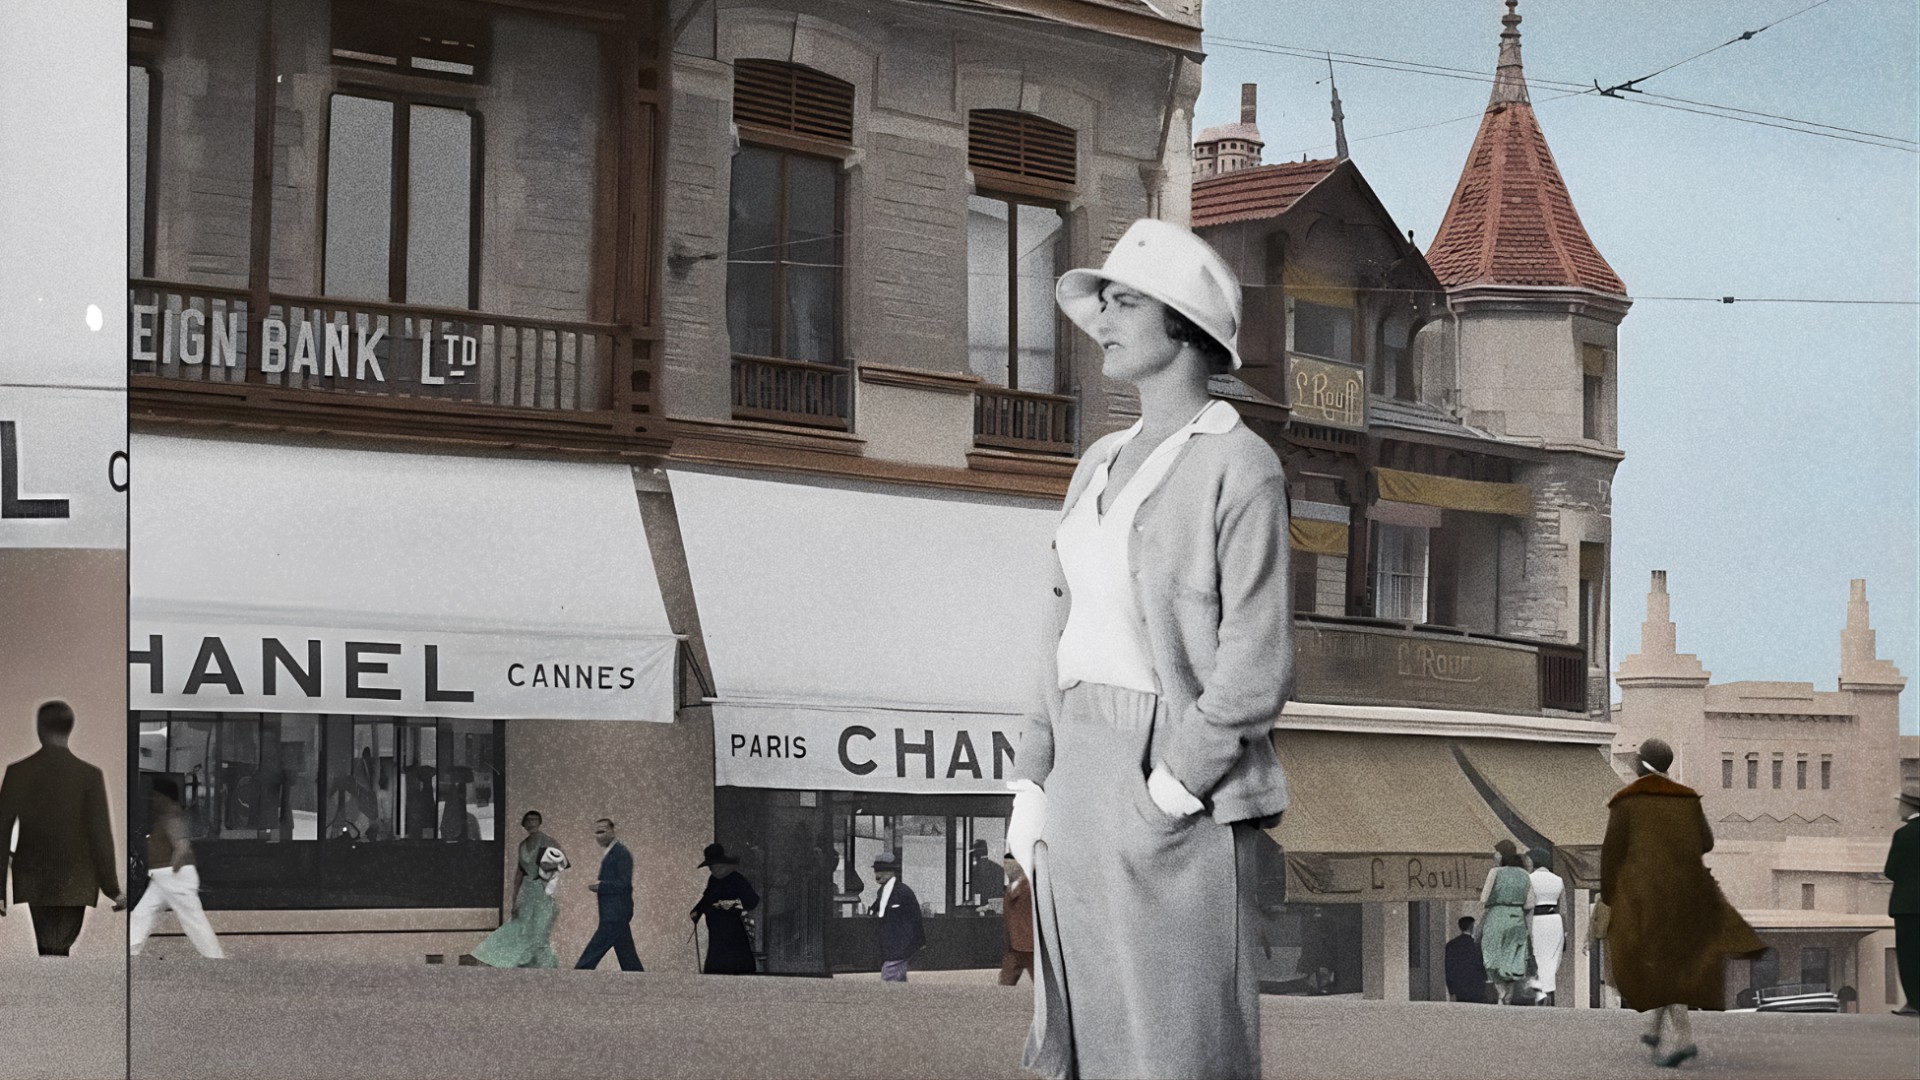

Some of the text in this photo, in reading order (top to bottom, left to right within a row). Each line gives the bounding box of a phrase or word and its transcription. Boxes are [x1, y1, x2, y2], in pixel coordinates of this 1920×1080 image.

[131, 304, 238, 368] EIGN
[261, 318, 385, 383] BANK
[0, 420, 70, 519] L
[129, 634, 636, 703] HANEL CANNES
[730, 725, 1023, 780] PARIS CHAN
